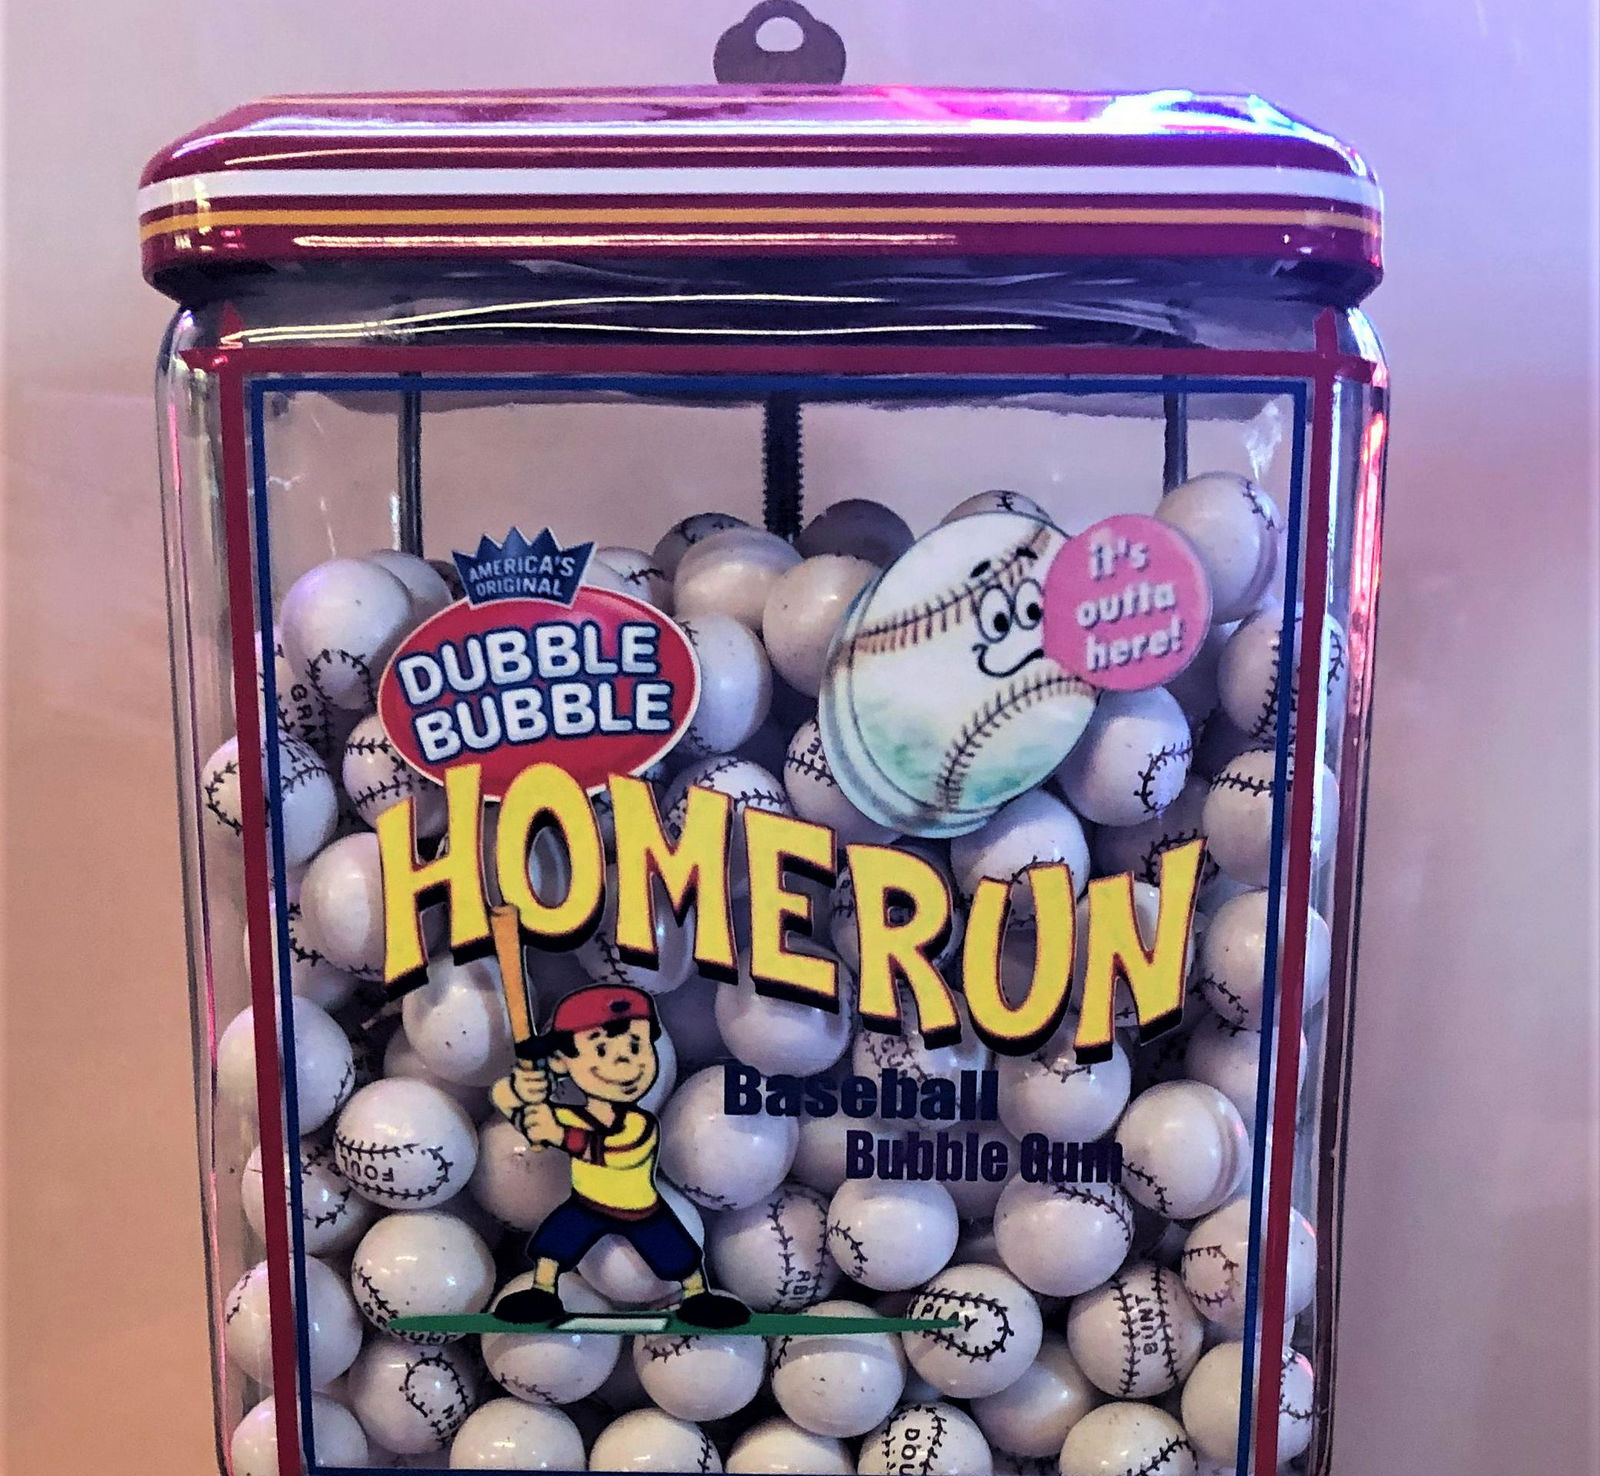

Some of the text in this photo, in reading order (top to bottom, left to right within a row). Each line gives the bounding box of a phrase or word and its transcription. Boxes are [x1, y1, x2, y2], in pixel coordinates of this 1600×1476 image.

[469, 555, 576, 583] AMERICA'S
[1089, 527, 1149, 580] it's
[475, 577, 563, 597] ORIGINAL
[1077, 581, 1176, 631] outta
[398, 622, 659, 706] DUBBLE
[1086, 614, 1183, 673] here!
[414, 680, 673, 763] BUBBLE
[374, 762, 1206, 1063] HOMERUN
[723, 1063, 998, 1121] Baseball
[846, 1129, 1123, 1184] Bubble Gum
